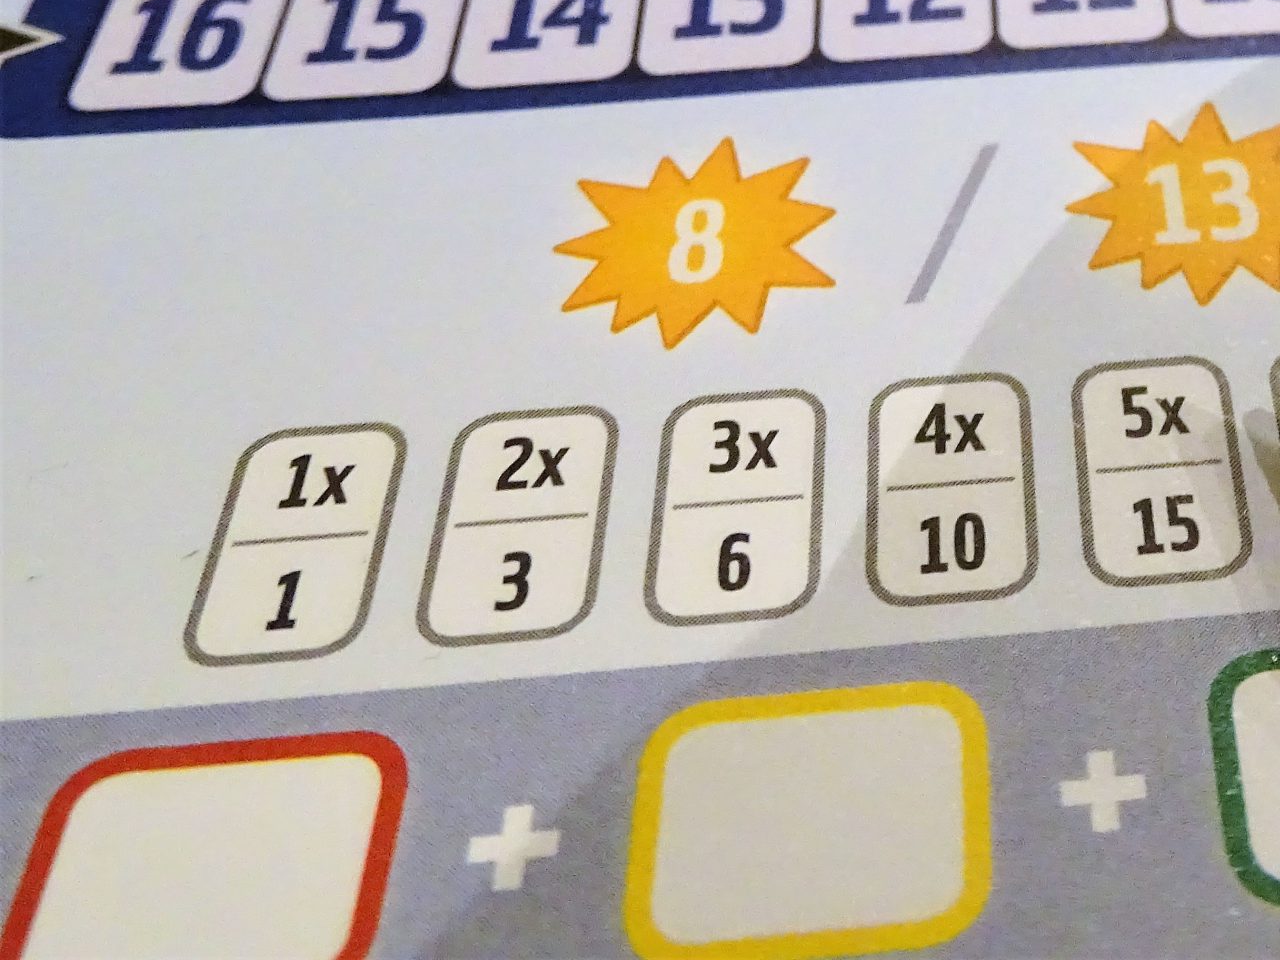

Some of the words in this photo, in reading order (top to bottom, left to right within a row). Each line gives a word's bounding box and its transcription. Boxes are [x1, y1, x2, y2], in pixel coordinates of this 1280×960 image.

[666, 198, 726, 285] 8
[1143, 158, 1261, 247] 13
[277, 454, 354, 509] 1x
[496, 438, 569, 491] 2x
[709, 420, 780, 474] 3x
[915, 403, 986, 455] 4x
[1121, 385, 1191, 438] 5x
[265, 570, 302, 630] 1
[494, 552, 533, 612] 3
[717, 533, 752, 591] 6
[919, 512, 986, 576] 10
[1132, 494, 1201, 556] 15
